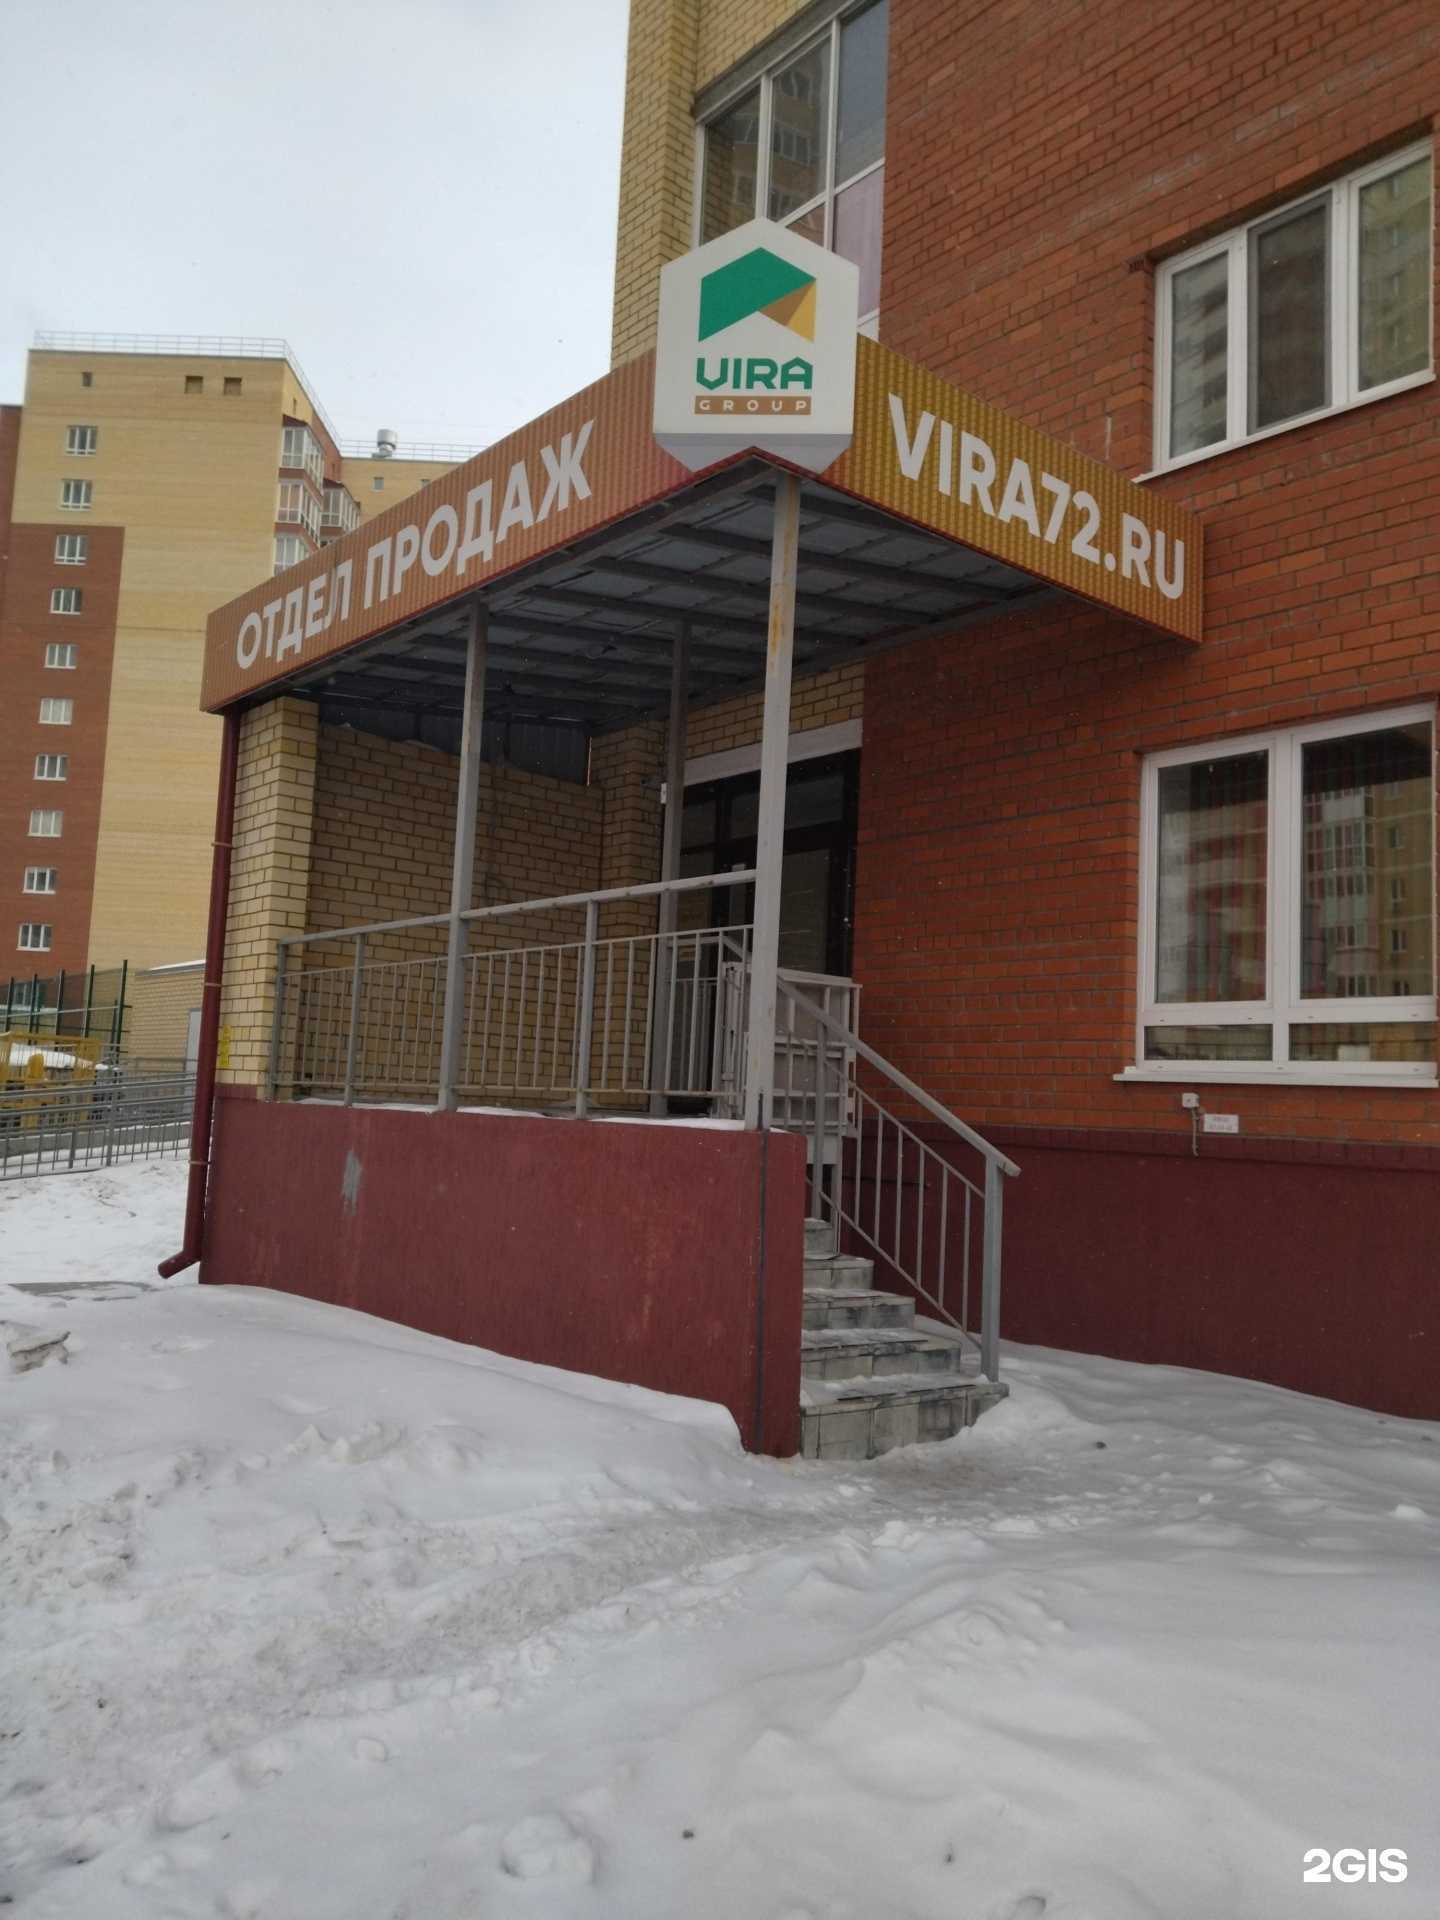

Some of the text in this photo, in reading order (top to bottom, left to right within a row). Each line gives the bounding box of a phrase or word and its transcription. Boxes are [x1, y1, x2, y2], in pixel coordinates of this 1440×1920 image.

[696, 357, 813, 390] VIRA
[699, 400, 808, 412] GROUP
[236, 419, 594, 670] ОТДЕЛ ПРОДАЖ
[888, 392, 1185, 600] VIRA72.RU
